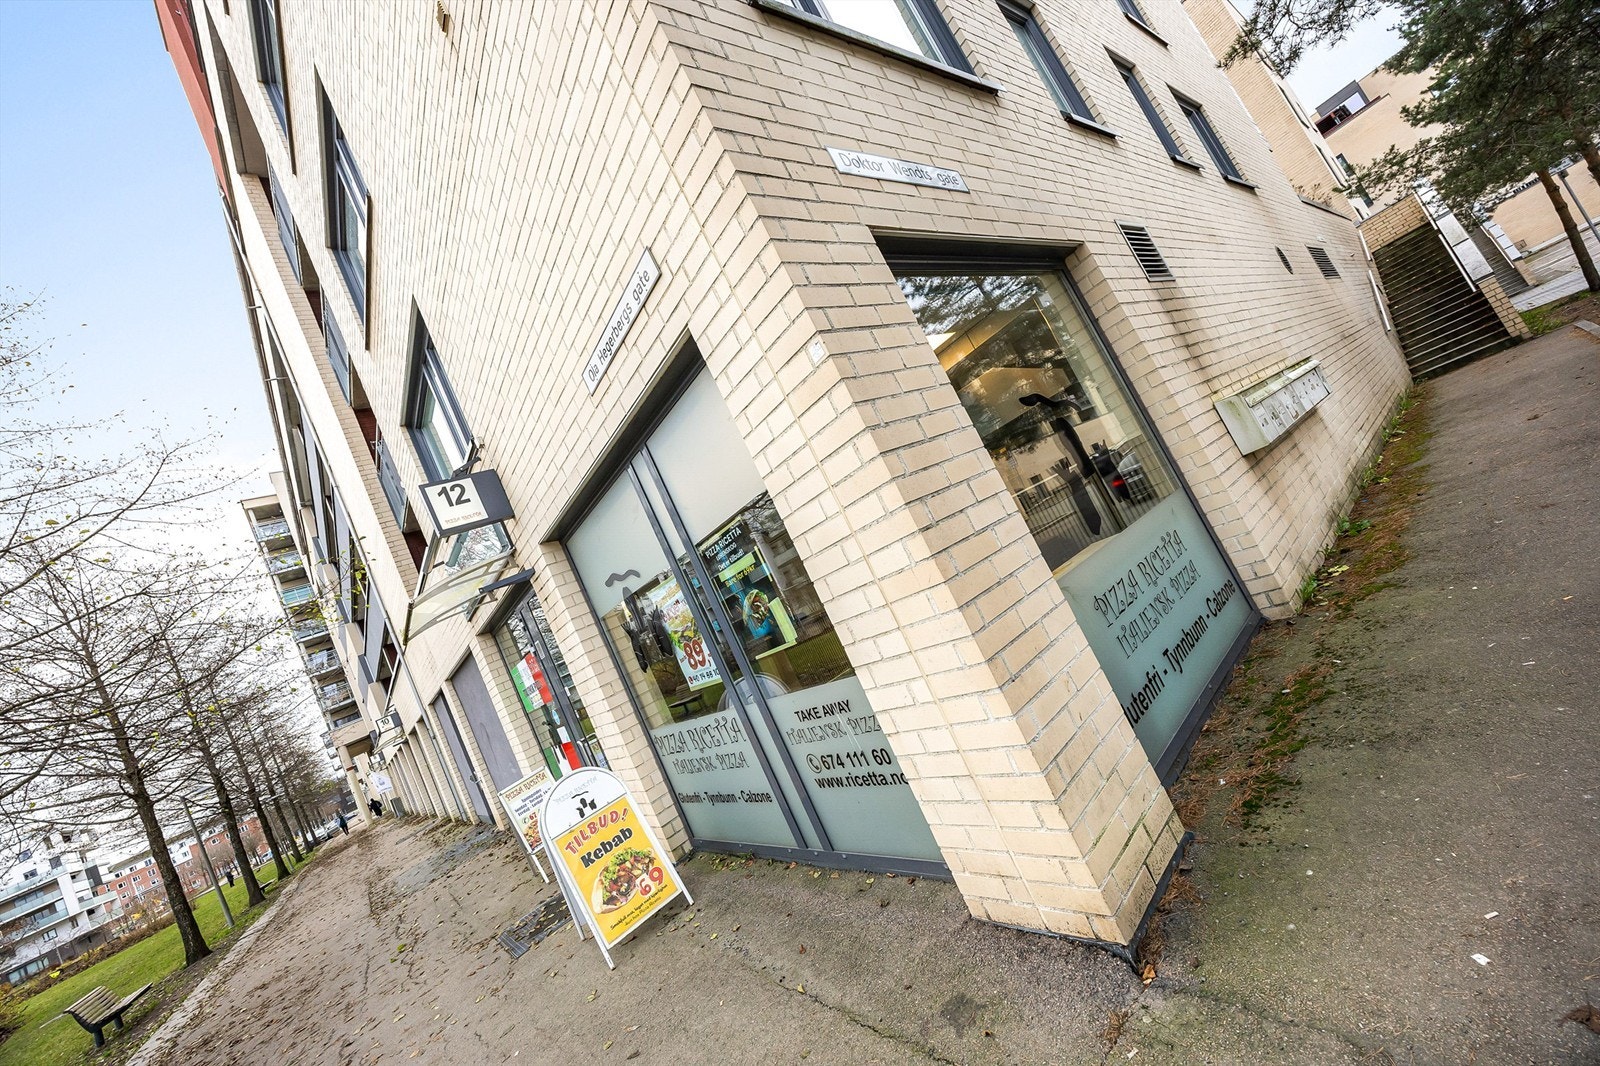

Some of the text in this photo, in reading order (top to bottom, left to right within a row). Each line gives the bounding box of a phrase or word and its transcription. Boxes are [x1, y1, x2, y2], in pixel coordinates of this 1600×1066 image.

[838, 152, 960, 185] Doktor Wendts gate
[588, 270, 650, 382] Ola Hegerbergs gate
[437, 483, 471, 508] 12
[705, 527, 742, 559] PIZZA RICETTA
[1093, 529, 1188, 628] PIZZA RICETTA
[1116, 559, 1201, 659] ITALIENSK PIZZA
[1120, 665, 1166, 729] lutenfri
[1162, 614, 1209, 674] Tynnbunn
[1206, 578, 1236, 618] Calzone
[381, 718, 390, 726] 10
[794, 700, 852, 722] TAKE AWAY
[654, 716, 746, 756] PIZZA RICETTA
[786, 714, 881, 745] ITALIENSK PIZZ
[672, 751, 749, 774] ITALIENSK PIZZA
[821, 748, 892, 770] 674 111 60
[814, 772, 909, 789] www.ricetta.no
[704, 792, 738, 806] Tynnbunn
[740, 790, 772, 802] Calzone
[565, 808, 628, 855] TILBUD!
[580, 827, 633, 868] Kebab
[640, 867, 663, 896] 69
